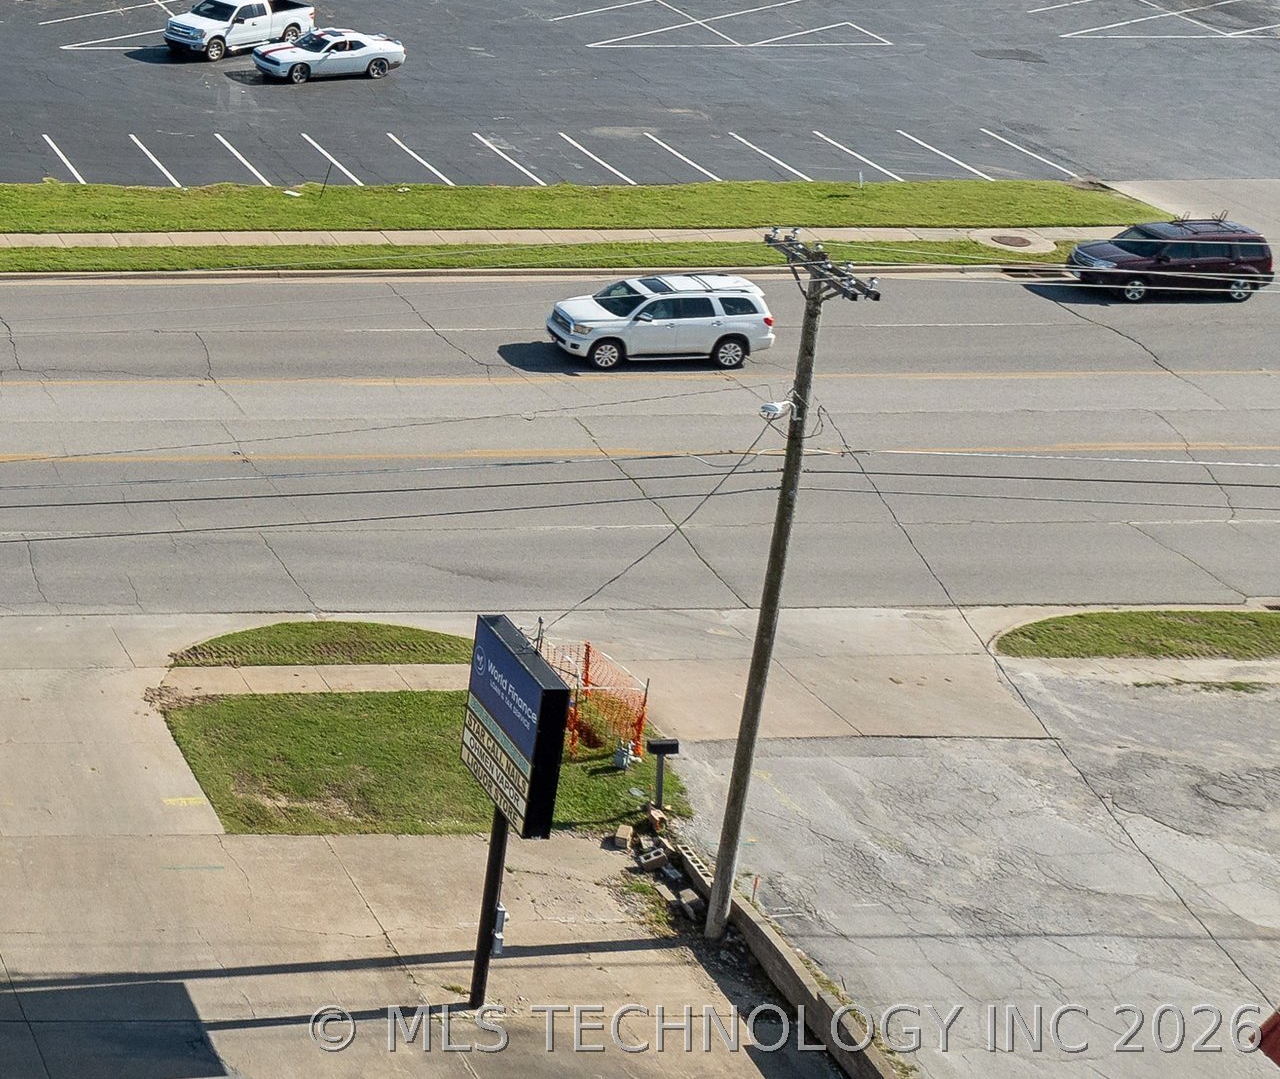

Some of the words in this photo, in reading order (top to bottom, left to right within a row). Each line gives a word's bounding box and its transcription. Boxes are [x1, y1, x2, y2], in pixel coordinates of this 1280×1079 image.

[487, 659, 507, 690] World
[508, 684, 537, 724] Finance
[466, 751, 493, 794] LIQUOR
[494, 788, 518, 826] STORE
[467, 713, 485, 741] STAR
[486, 737, 503, 766] CALL
[505, 759, 526, 794] NAILS
[469, 736, 494, 774] OHMEN
[495, 768, 519, 806] VAPOR
